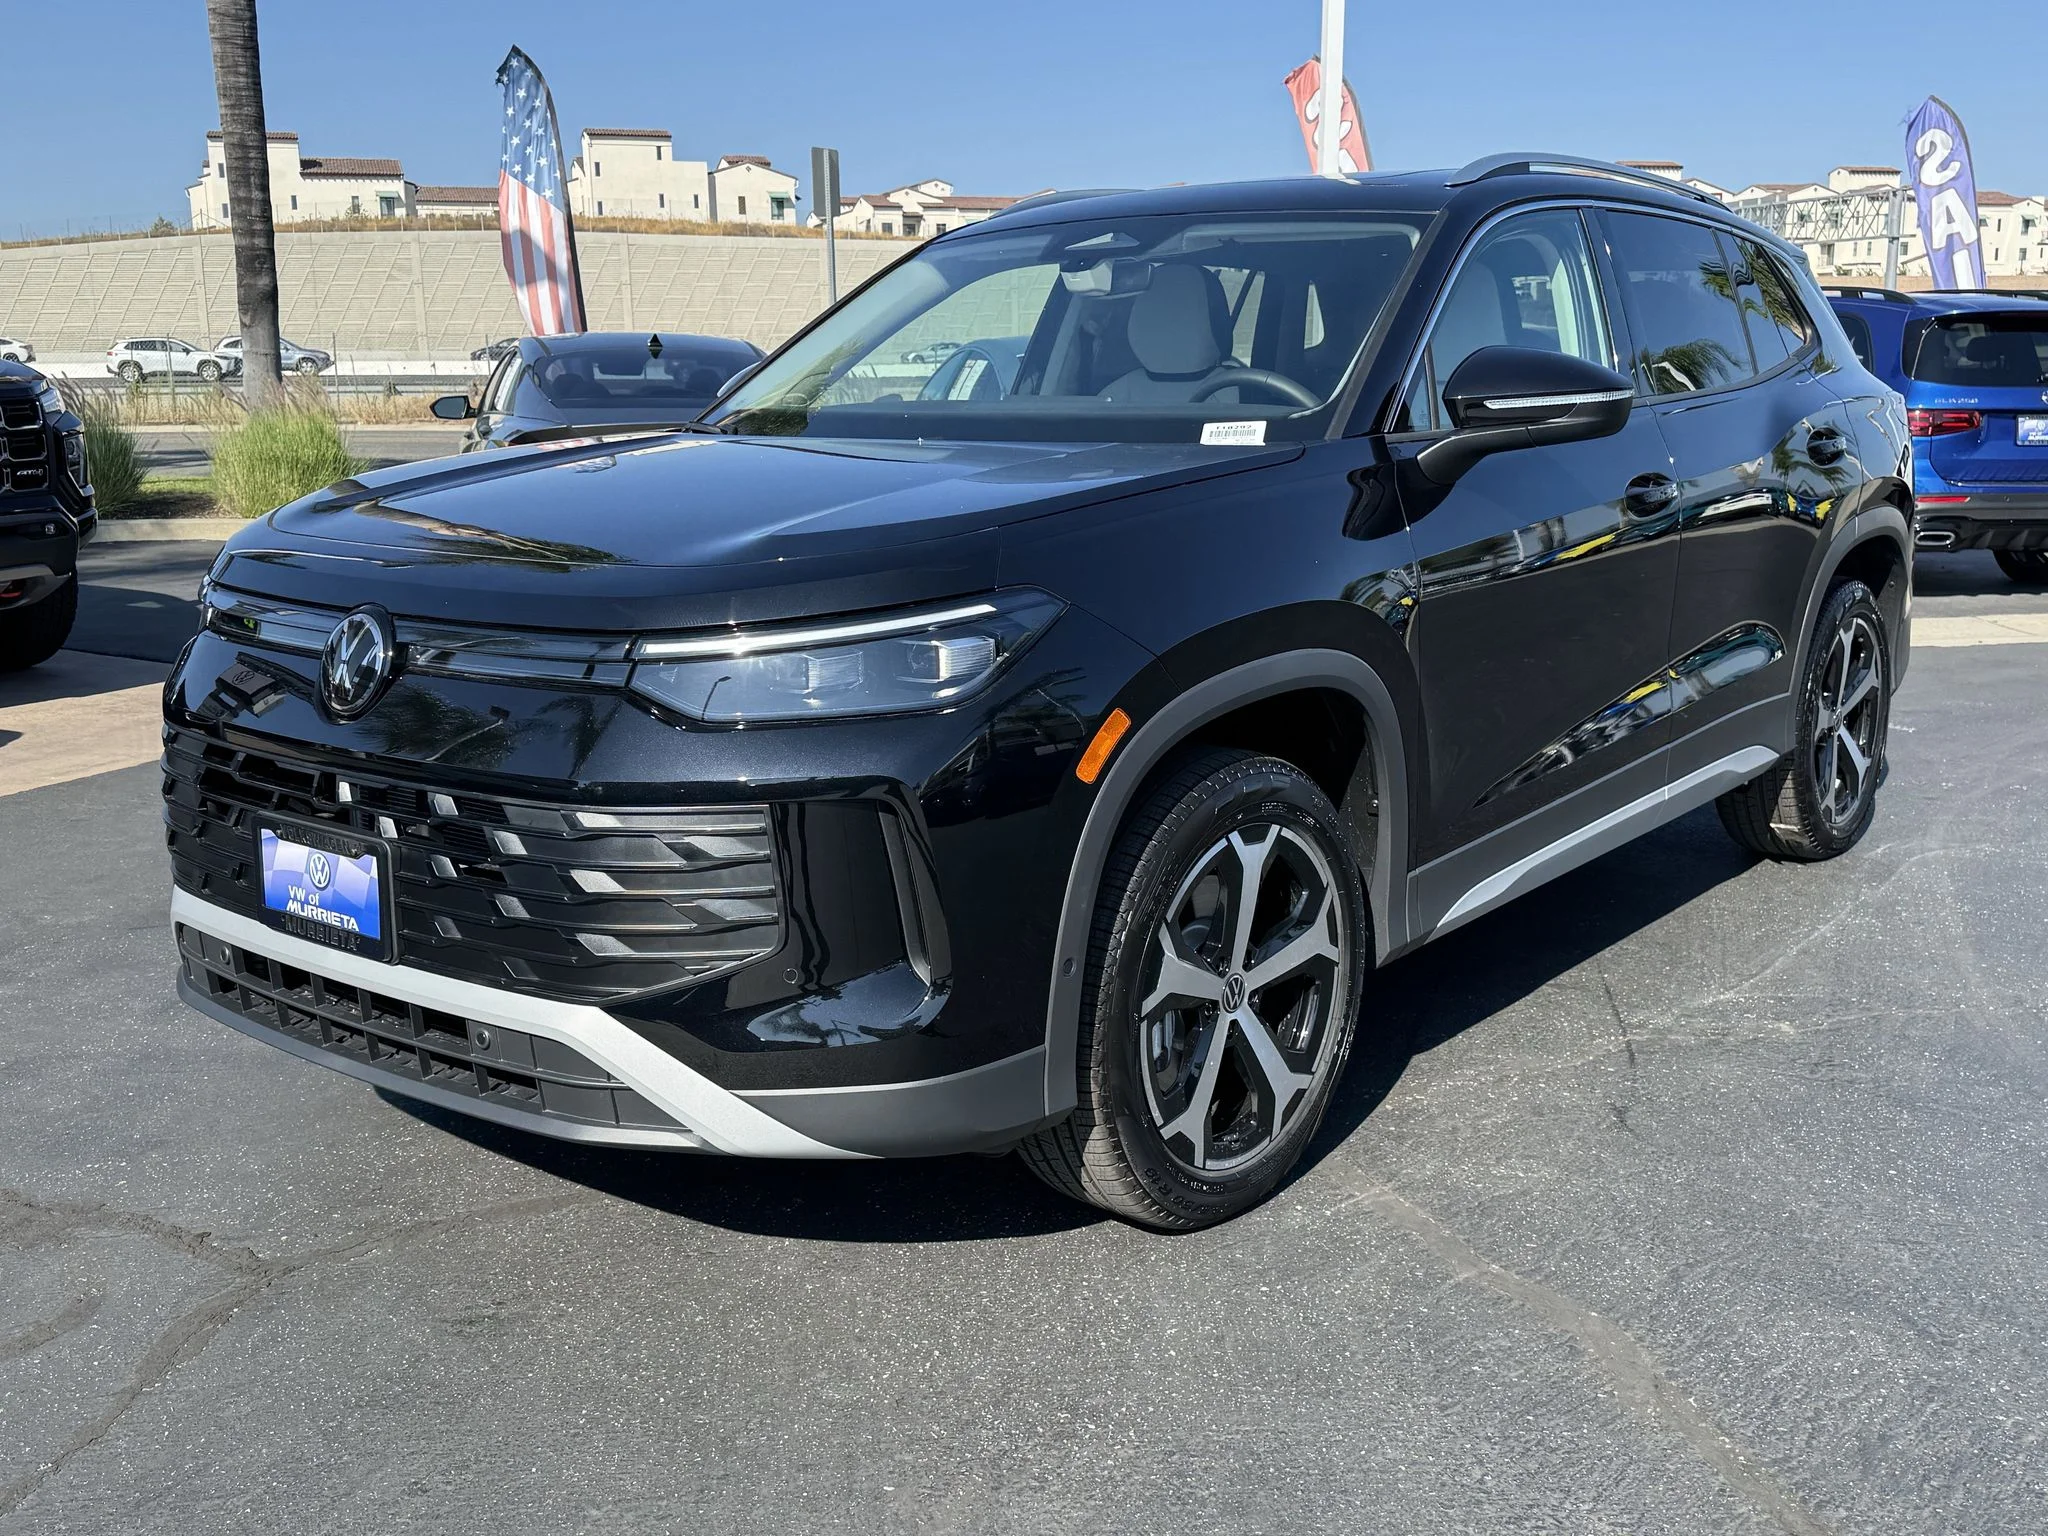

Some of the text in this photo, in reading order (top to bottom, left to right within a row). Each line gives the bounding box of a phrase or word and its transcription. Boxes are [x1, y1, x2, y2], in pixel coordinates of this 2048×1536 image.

[288, 885, 320, 906] VW of
[286, 899, 360, 932] MURRIETA
[285, 914, 360, 951] MURRIETA
